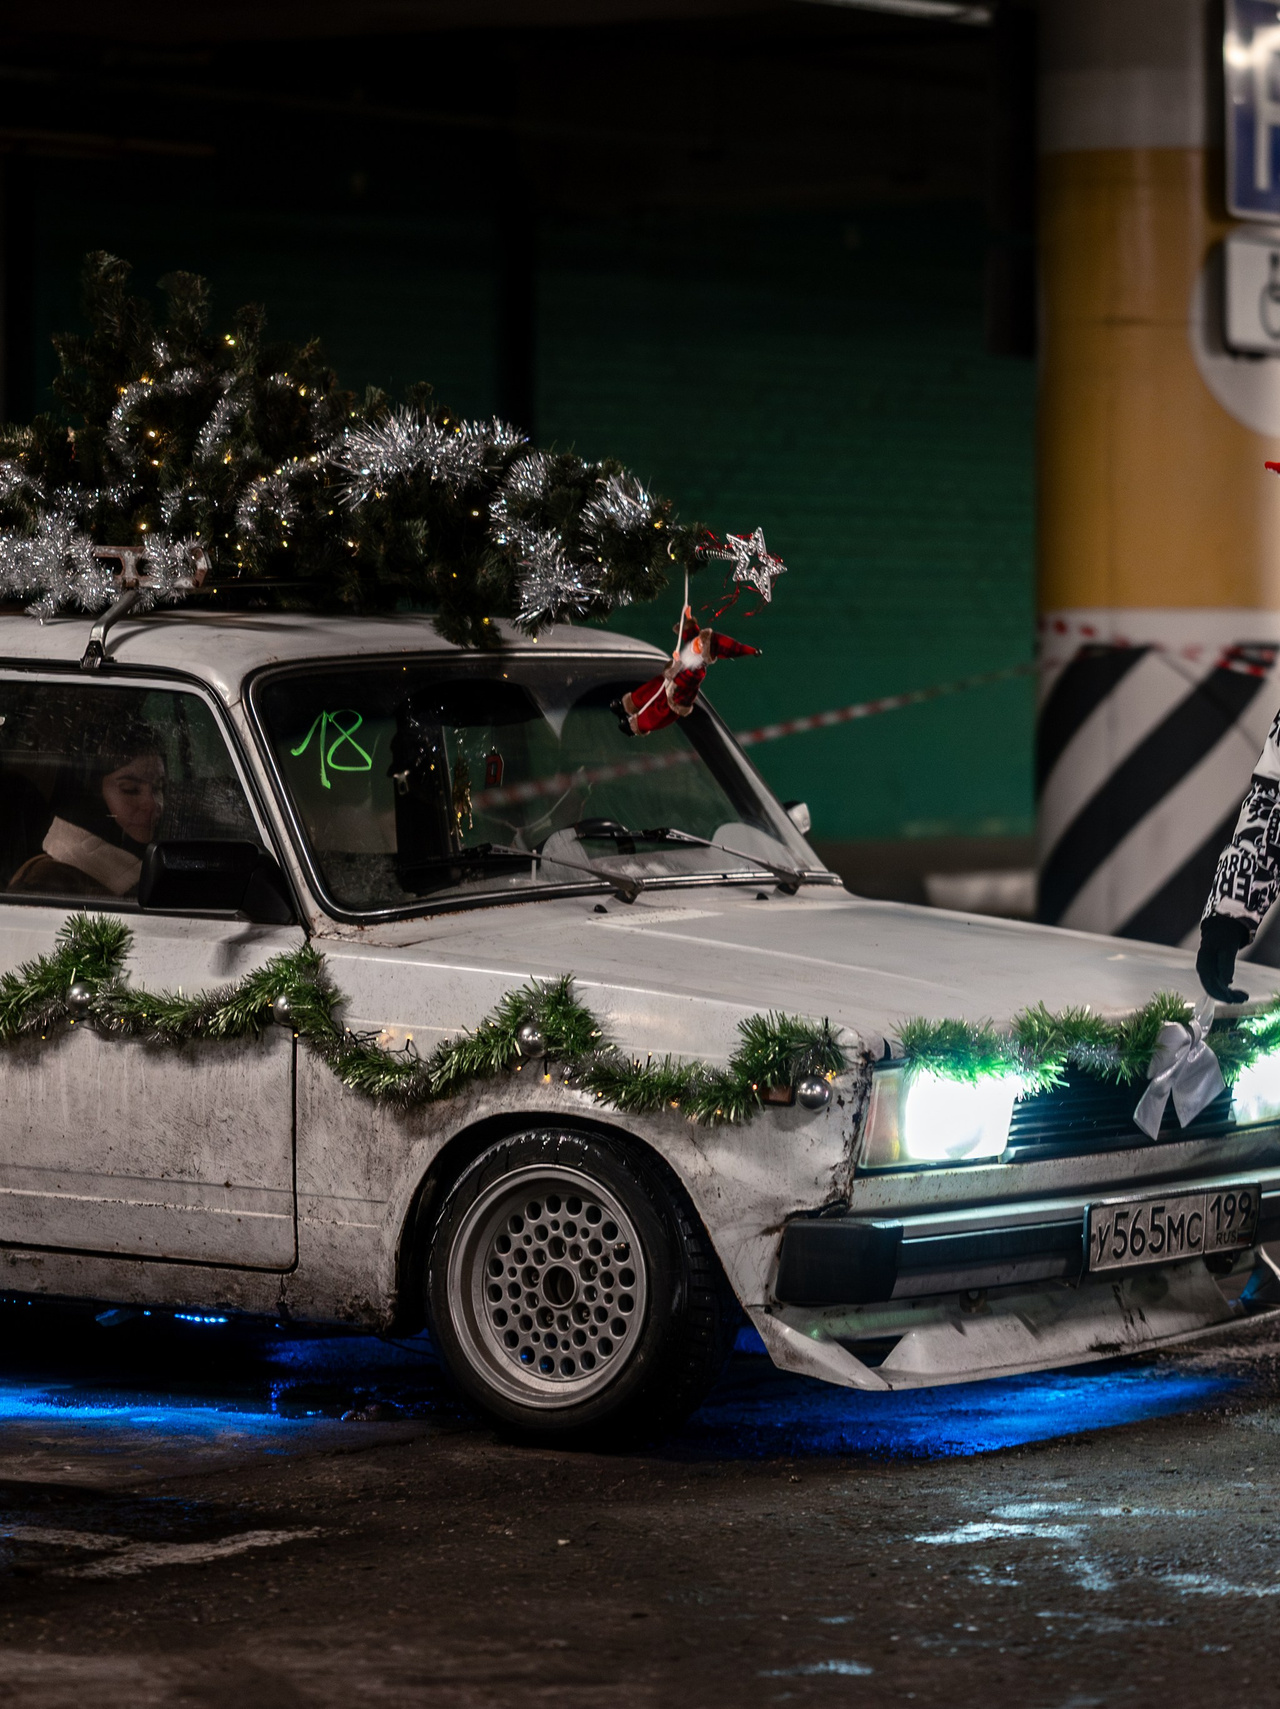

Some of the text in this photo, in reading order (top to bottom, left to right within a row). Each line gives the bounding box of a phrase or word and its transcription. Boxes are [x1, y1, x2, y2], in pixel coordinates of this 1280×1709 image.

[290, 709, 373, 789] 18
[1096, 1192, 1252, 1263] У565МС 199
[1216, 1229, 1237, 1246] RUS
